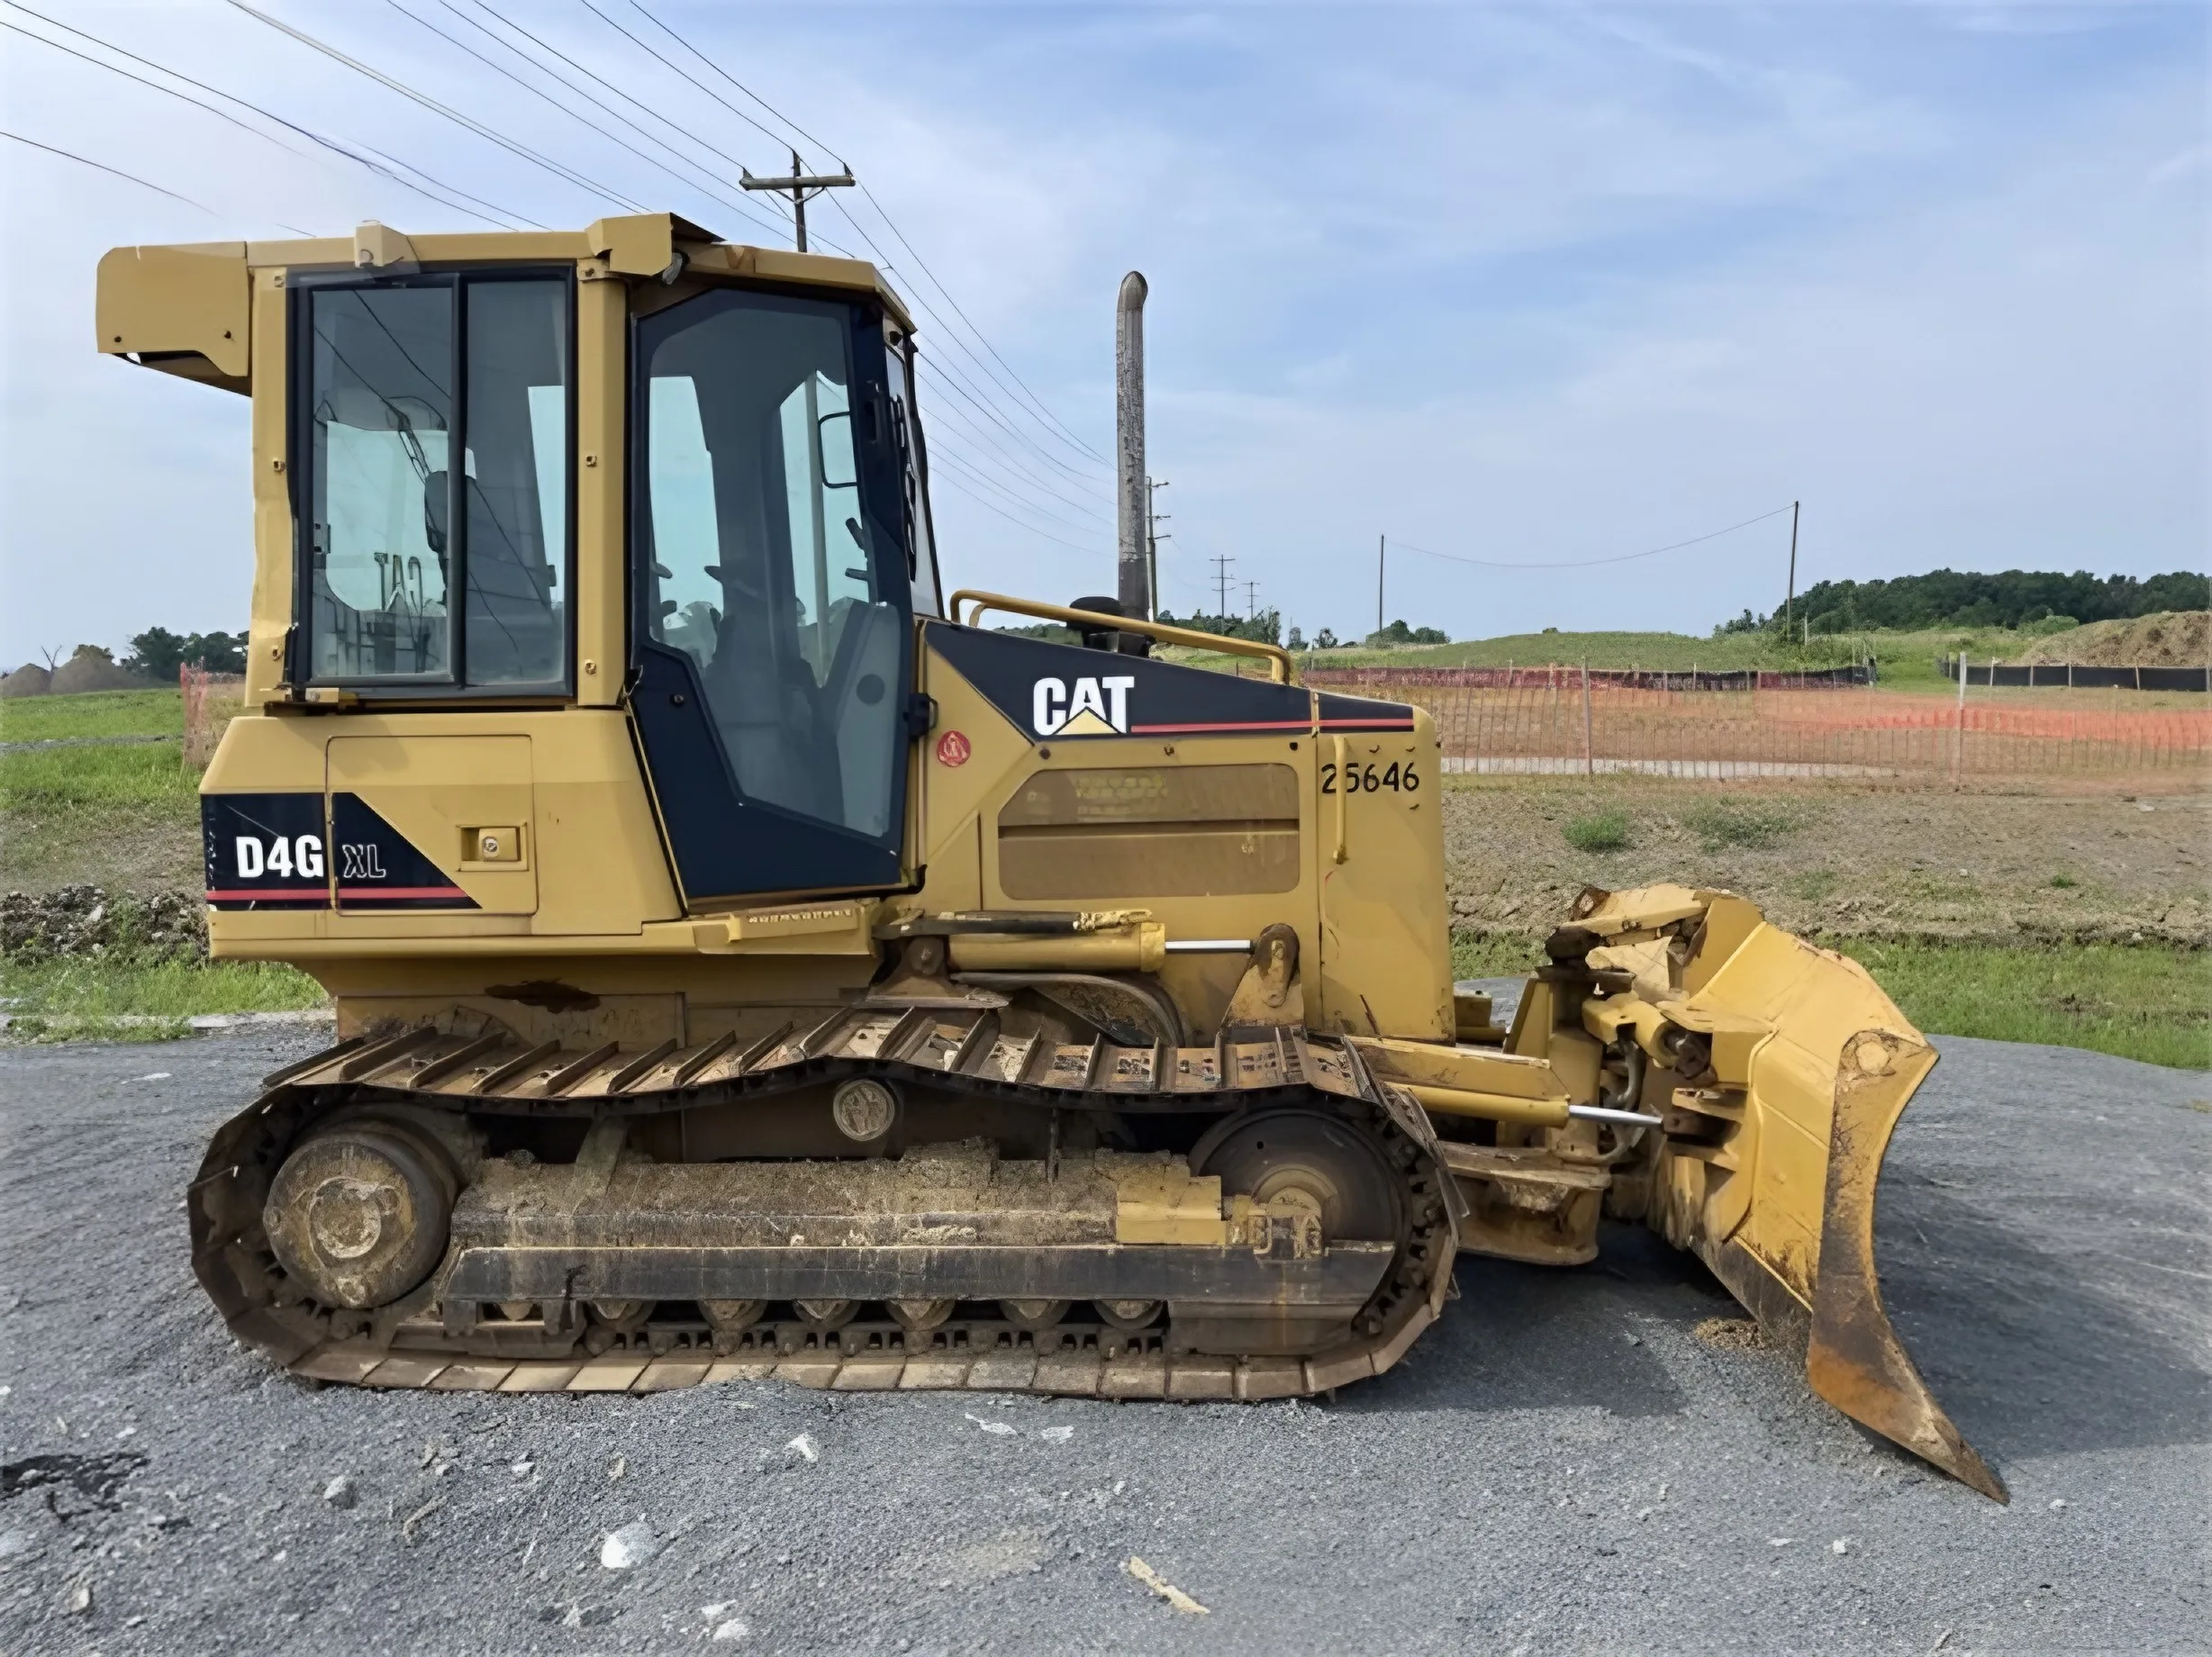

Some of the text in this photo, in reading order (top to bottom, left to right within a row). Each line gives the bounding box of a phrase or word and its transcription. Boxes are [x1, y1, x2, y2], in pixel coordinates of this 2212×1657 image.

[1033, 676, 1135, 736] CAT
[1321, 762, 1420, 793] 25646
[236, 834, 387, 878] D4G XL
